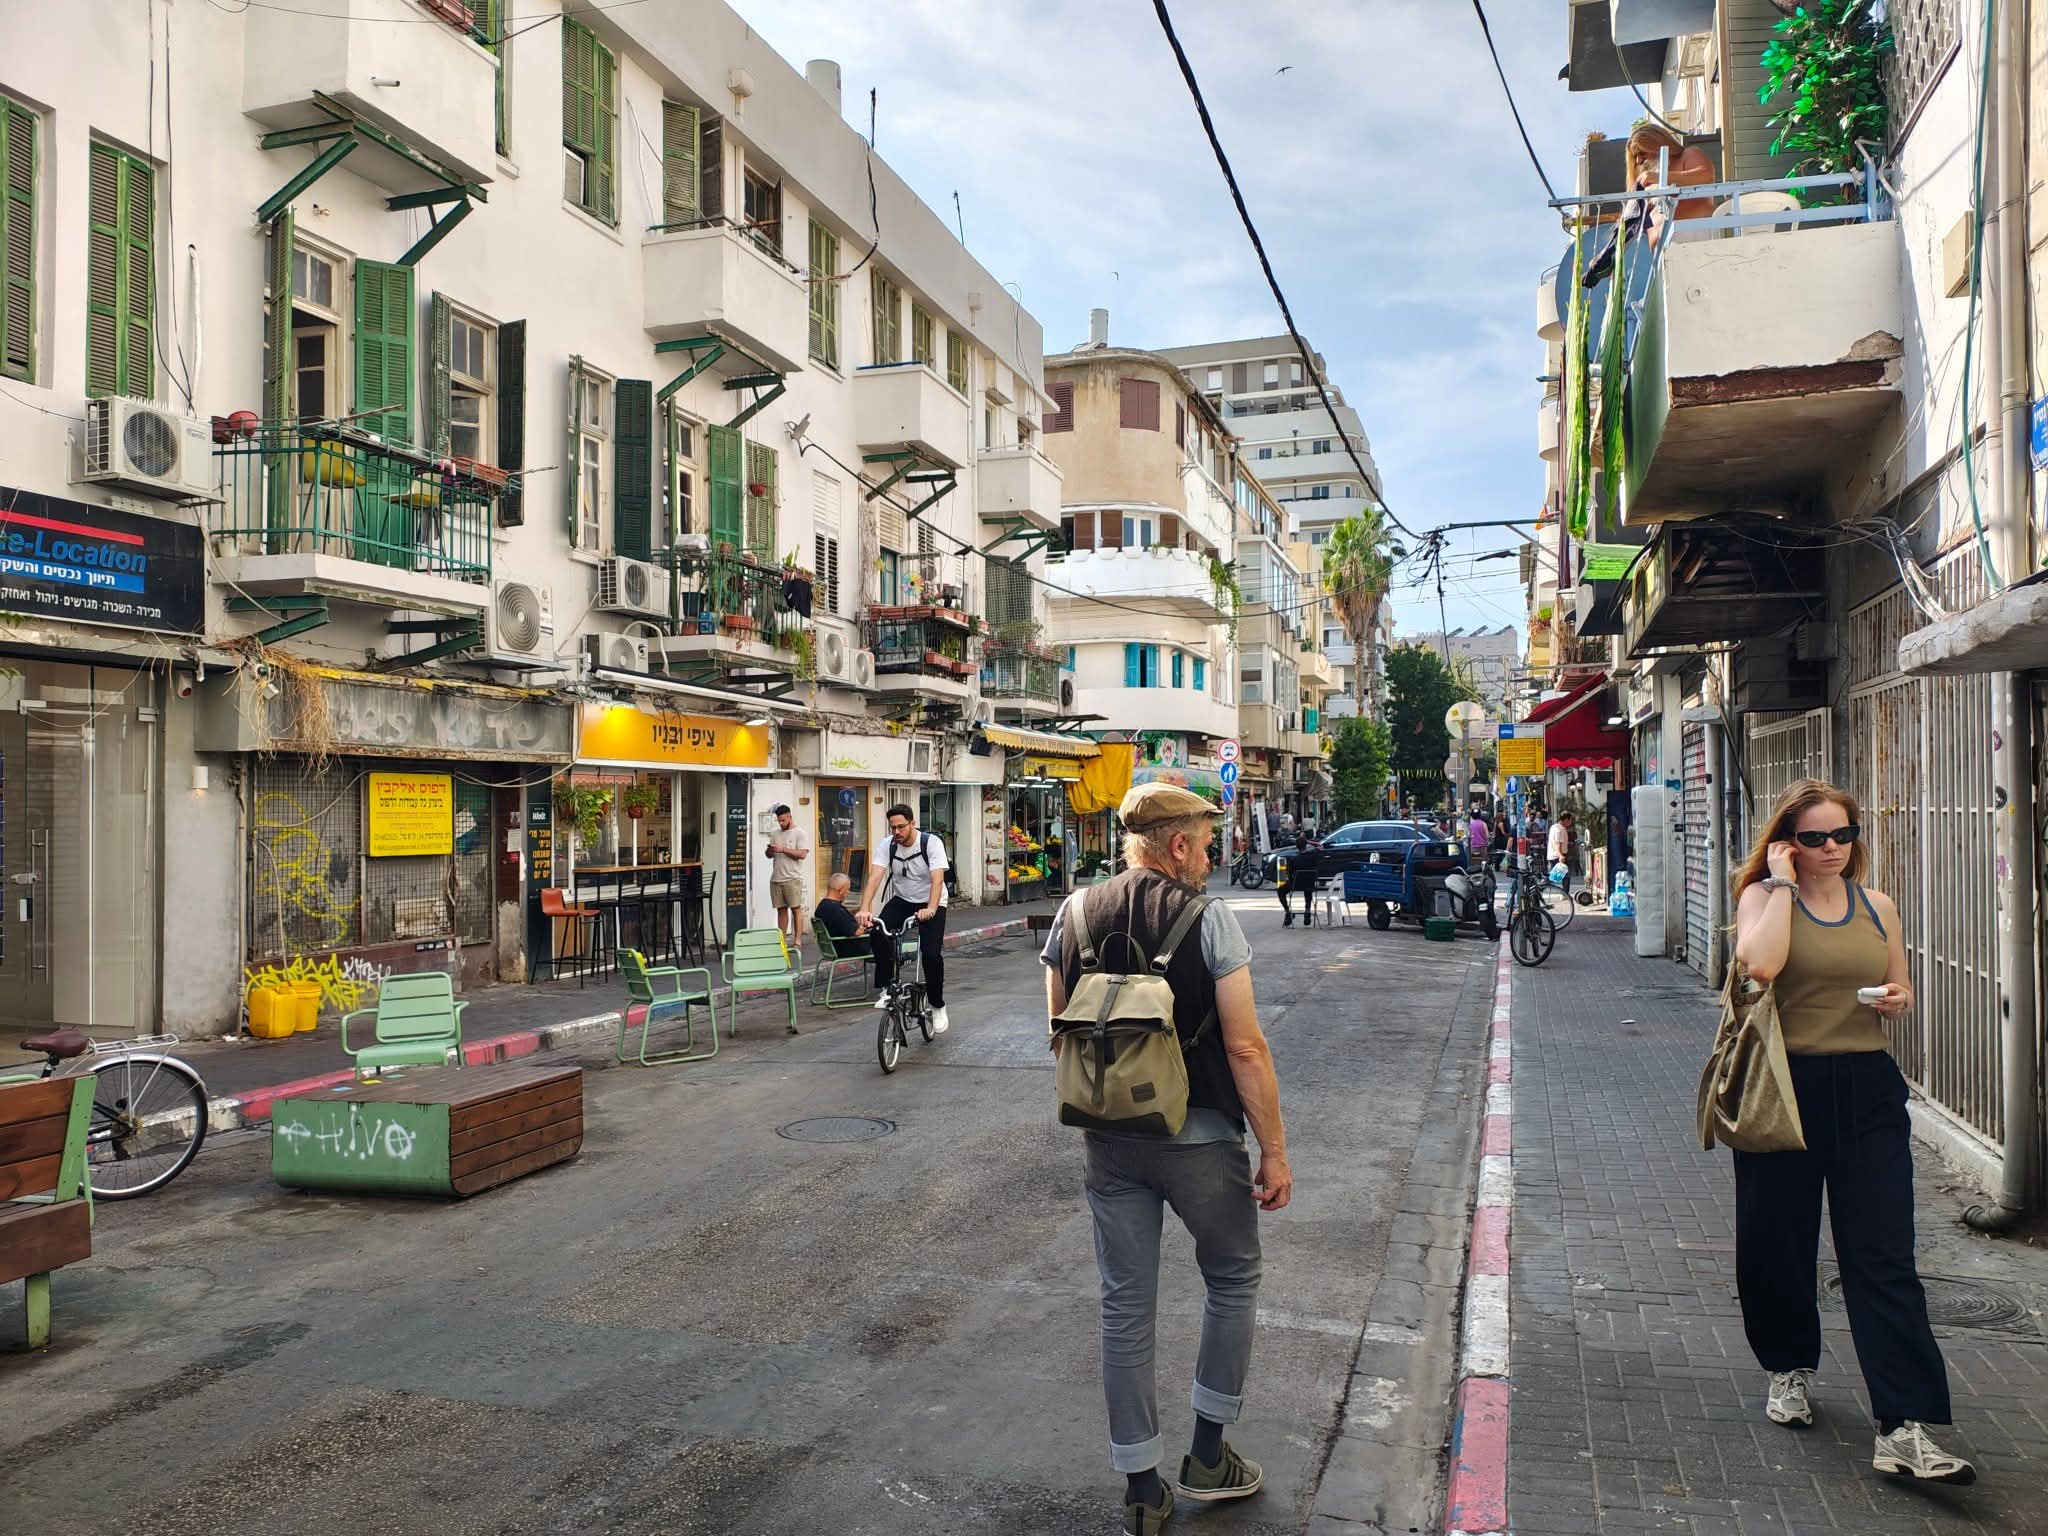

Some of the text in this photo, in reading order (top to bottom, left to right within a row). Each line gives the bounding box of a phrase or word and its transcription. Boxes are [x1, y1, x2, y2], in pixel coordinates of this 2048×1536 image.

[43, 565, 82, 580] נכסים
[86, 571, 115, 586] תיווך
[376, 780, 446, 797] דפוס אלקבץ
